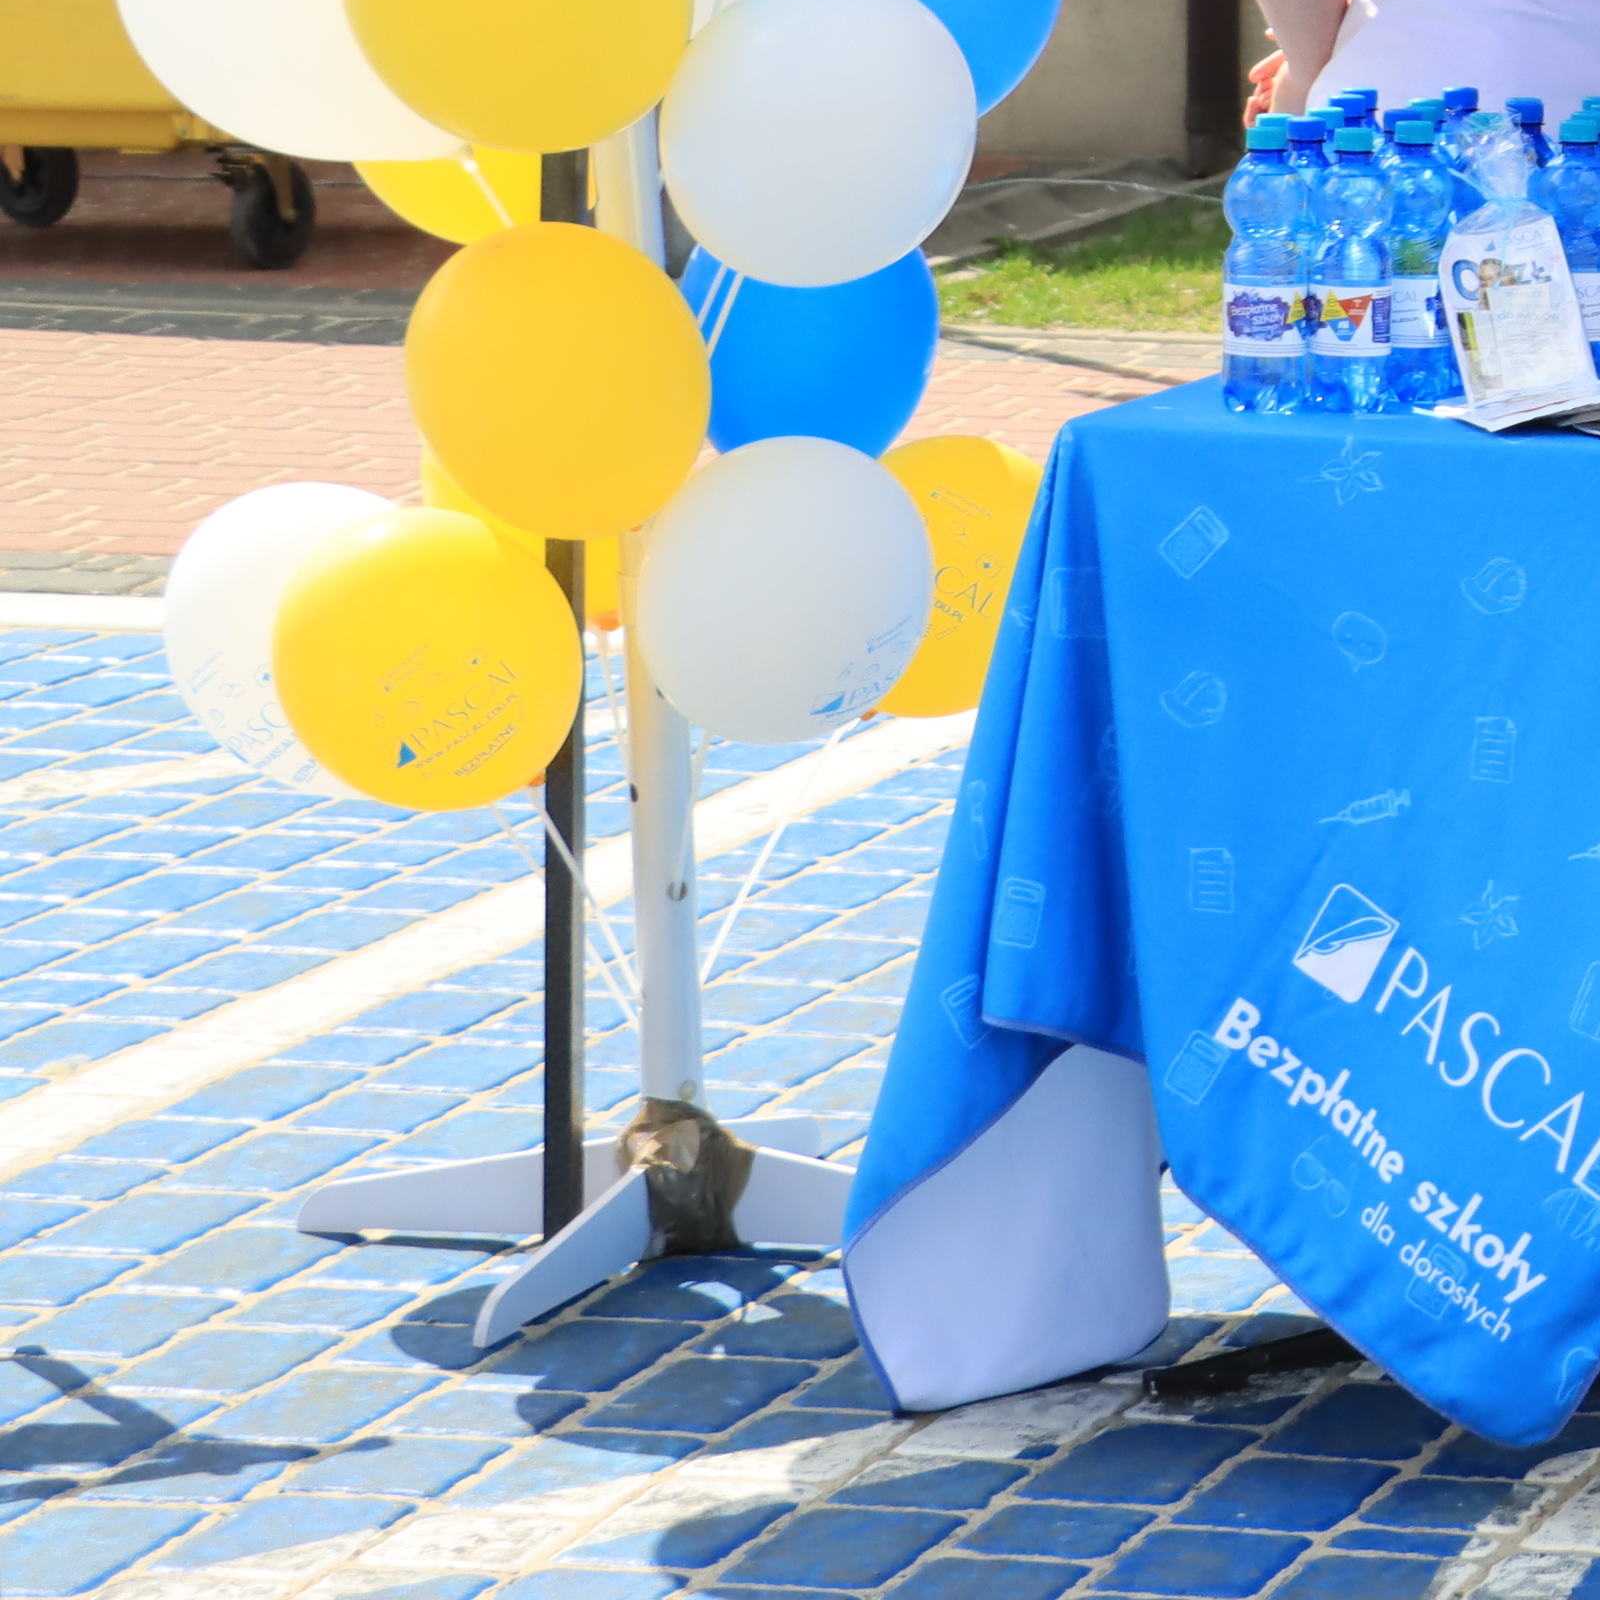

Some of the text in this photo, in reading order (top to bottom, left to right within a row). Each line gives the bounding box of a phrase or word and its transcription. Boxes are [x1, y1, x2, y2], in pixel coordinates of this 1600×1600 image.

[1393, 289, 1418, 303] CAL
[933, 565, 995, 619] CAL
[226, 701, 290, 757] PASC
[410, 661, 524, 749] PASCAL
[414, 693, 519, 769] WWW.PASCAL.EDU.PL
[1213, 996, 1405, 1184] Bezpłatne
[1361, 1201, 1513, 1343] dla dorosłych
[1409, 1180, 1548, 1304] szkoły
